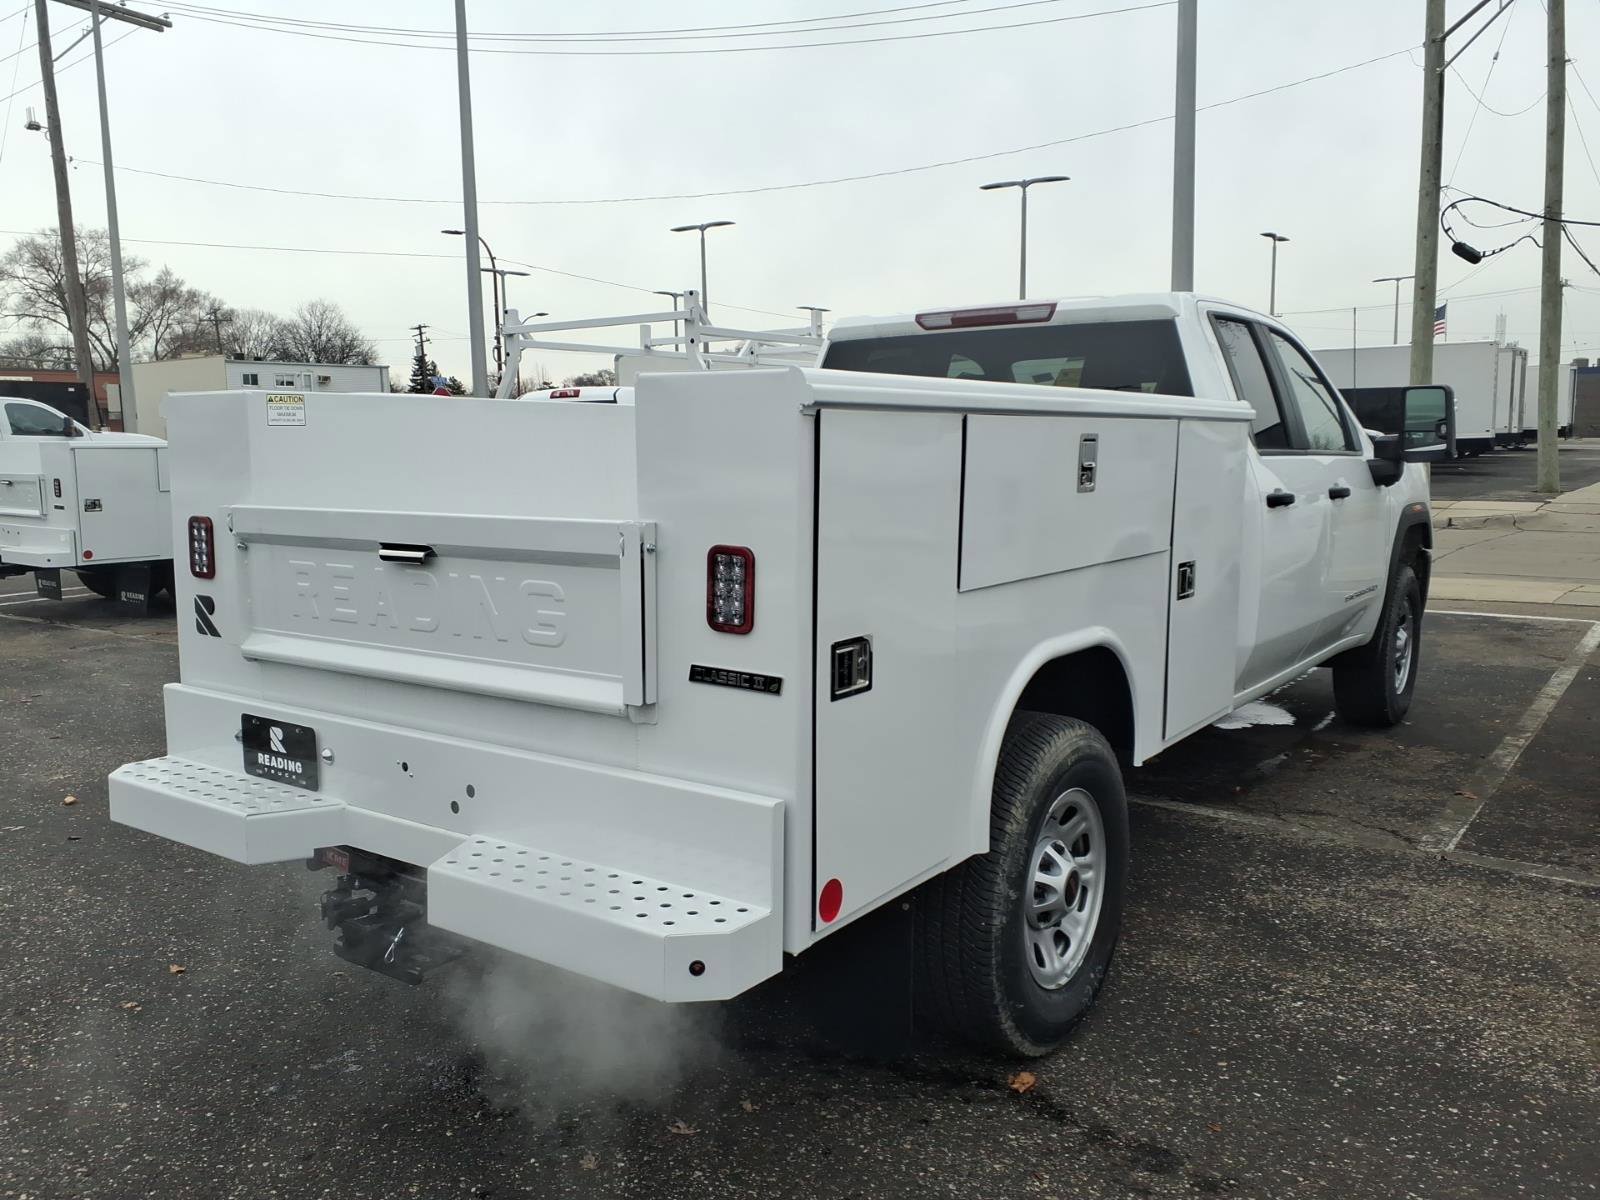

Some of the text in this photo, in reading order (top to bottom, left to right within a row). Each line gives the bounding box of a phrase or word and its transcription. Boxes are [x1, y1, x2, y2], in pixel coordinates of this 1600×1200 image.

[273, 395, 304, 403] CAUTION
[289, 560, 567, 648] READING
[692, 667, 750, 688] CLASSIC
[257, 752, 303, 774] READING
